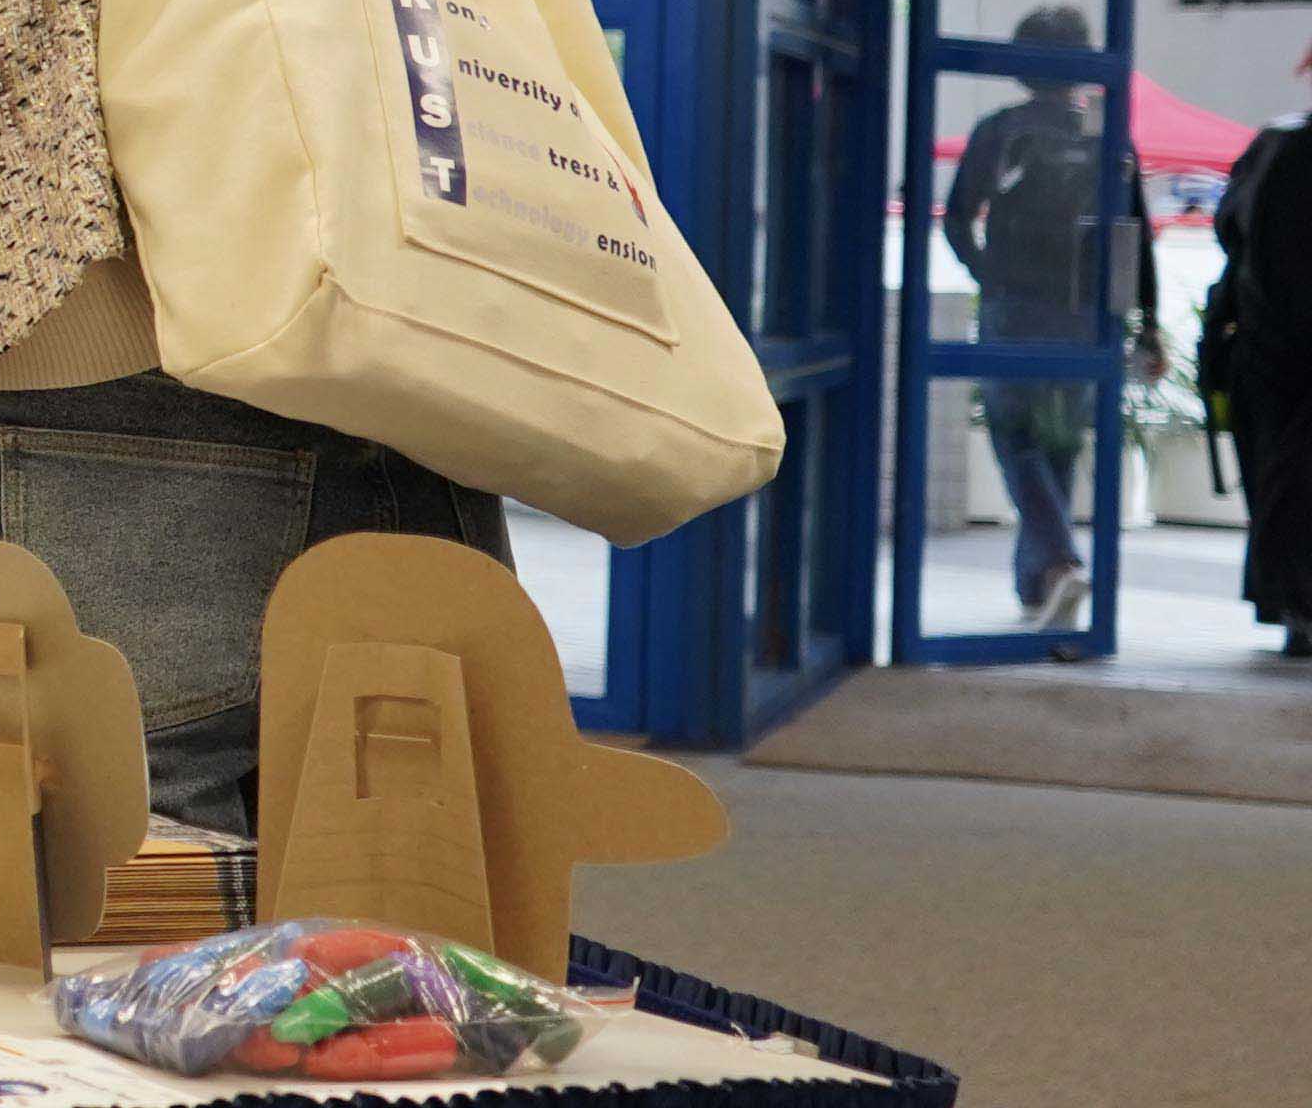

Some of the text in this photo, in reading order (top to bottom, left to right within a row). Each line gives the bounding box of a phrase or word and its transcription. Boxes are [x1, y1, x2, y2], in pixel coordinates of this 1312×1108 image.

[458, 58, 562, 112] niversity
[548, 147, 600, 183] tress
[606, 169, 621, 192] &
[597, 233, 658, 273] ension
